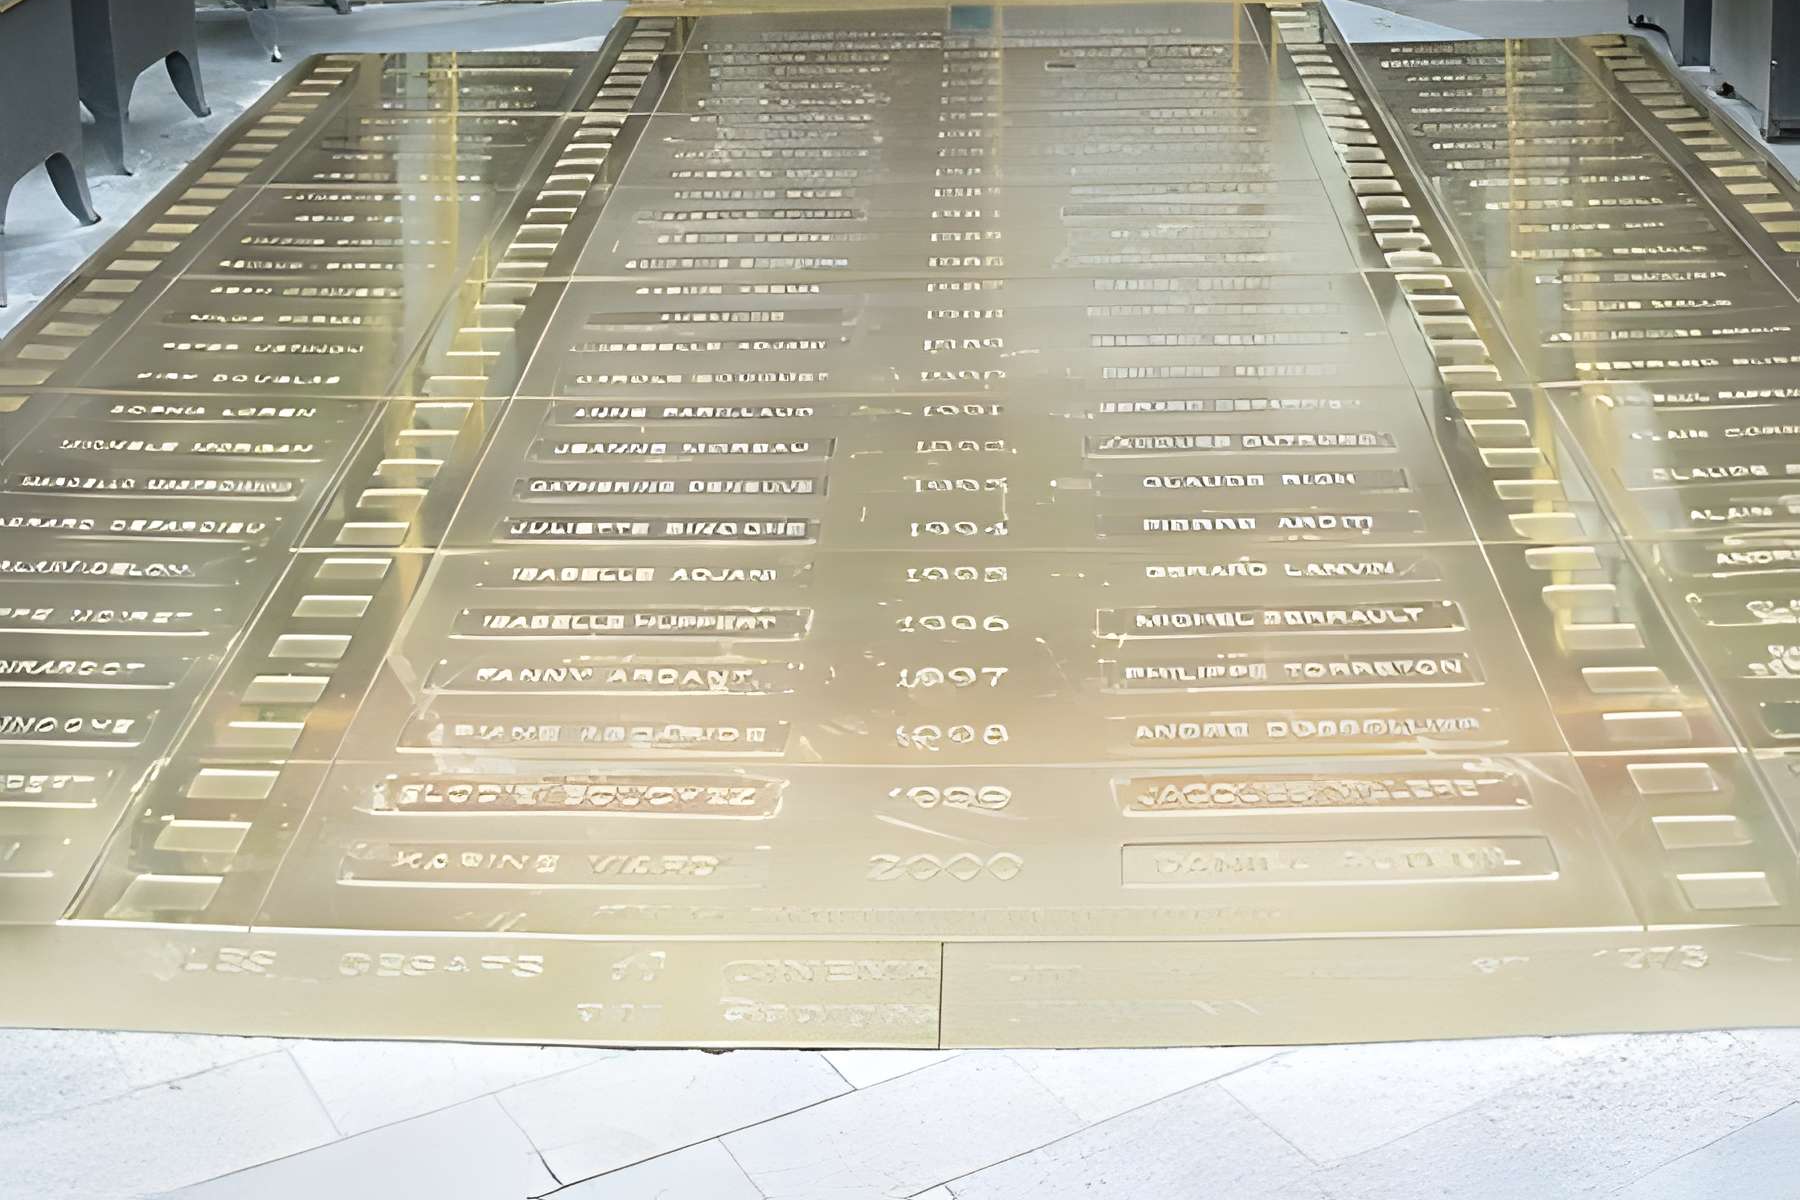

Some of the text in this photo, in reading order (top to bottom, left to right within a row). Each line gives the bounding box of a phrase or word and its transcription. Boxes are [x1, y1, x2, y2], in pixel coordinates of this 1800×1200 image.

[896, 615, 1009, 632] 1996
[896, 666, 1009, 688] 1997
[866, 852, 1025, 882] 2000
